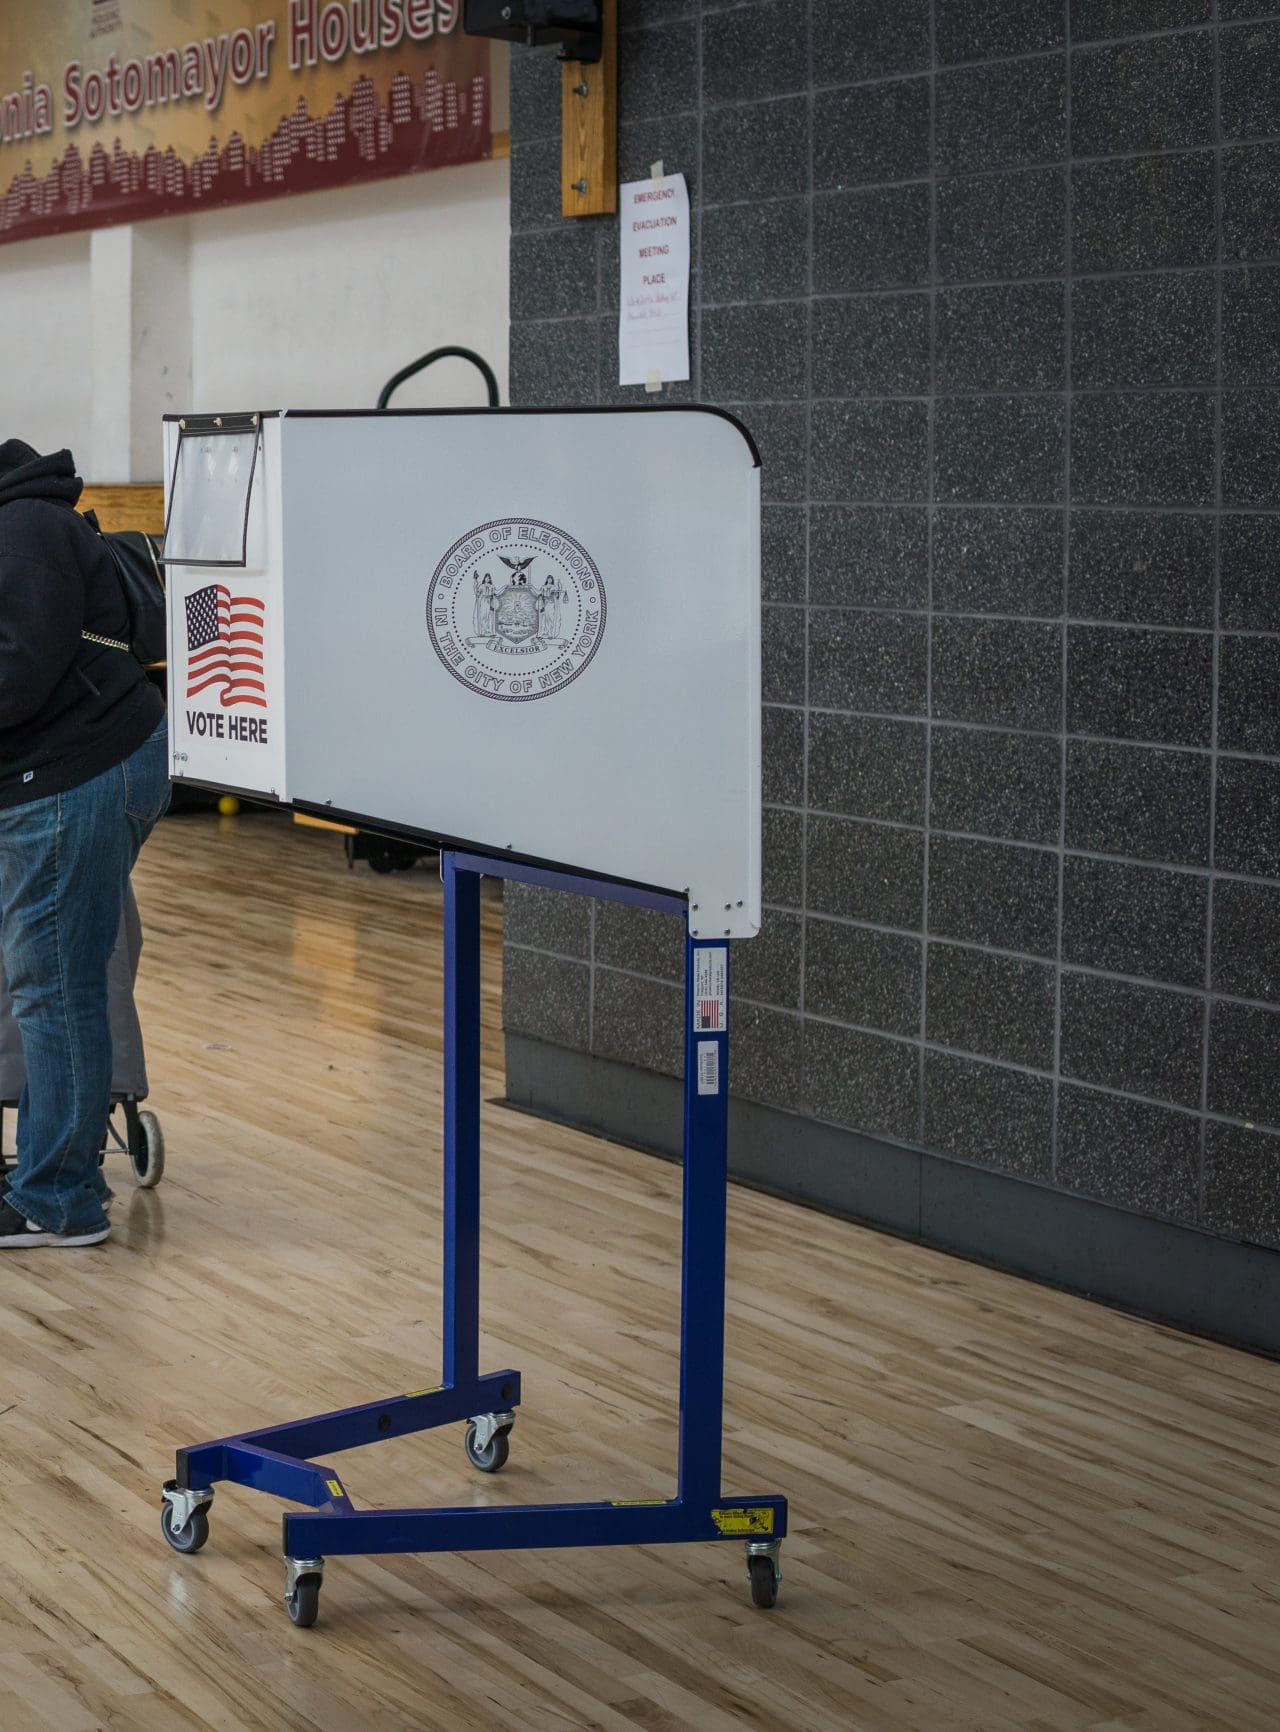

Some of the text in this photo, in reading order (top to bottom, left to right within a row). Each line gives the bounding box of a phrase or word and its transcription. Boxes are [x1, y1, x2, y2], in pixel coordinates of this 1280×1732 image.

[63, 19, 275, 127] Sotomayor
[634, 188, 675, 204] EMERGENCY
[632, 216, 677, 232] EVACUATION
[639, 244, 669, 258] MEETING
[642, 273, 665, 285] PLACE
[440, 526, 596, 591] BOARD OF ELECTIONS
[434, 607, 599, 693] IN THE CITY OF NEW YORK
[493, 645, 541, 654] EXCELSIOR
[186, 710, 268, 744] VOTE HERE
